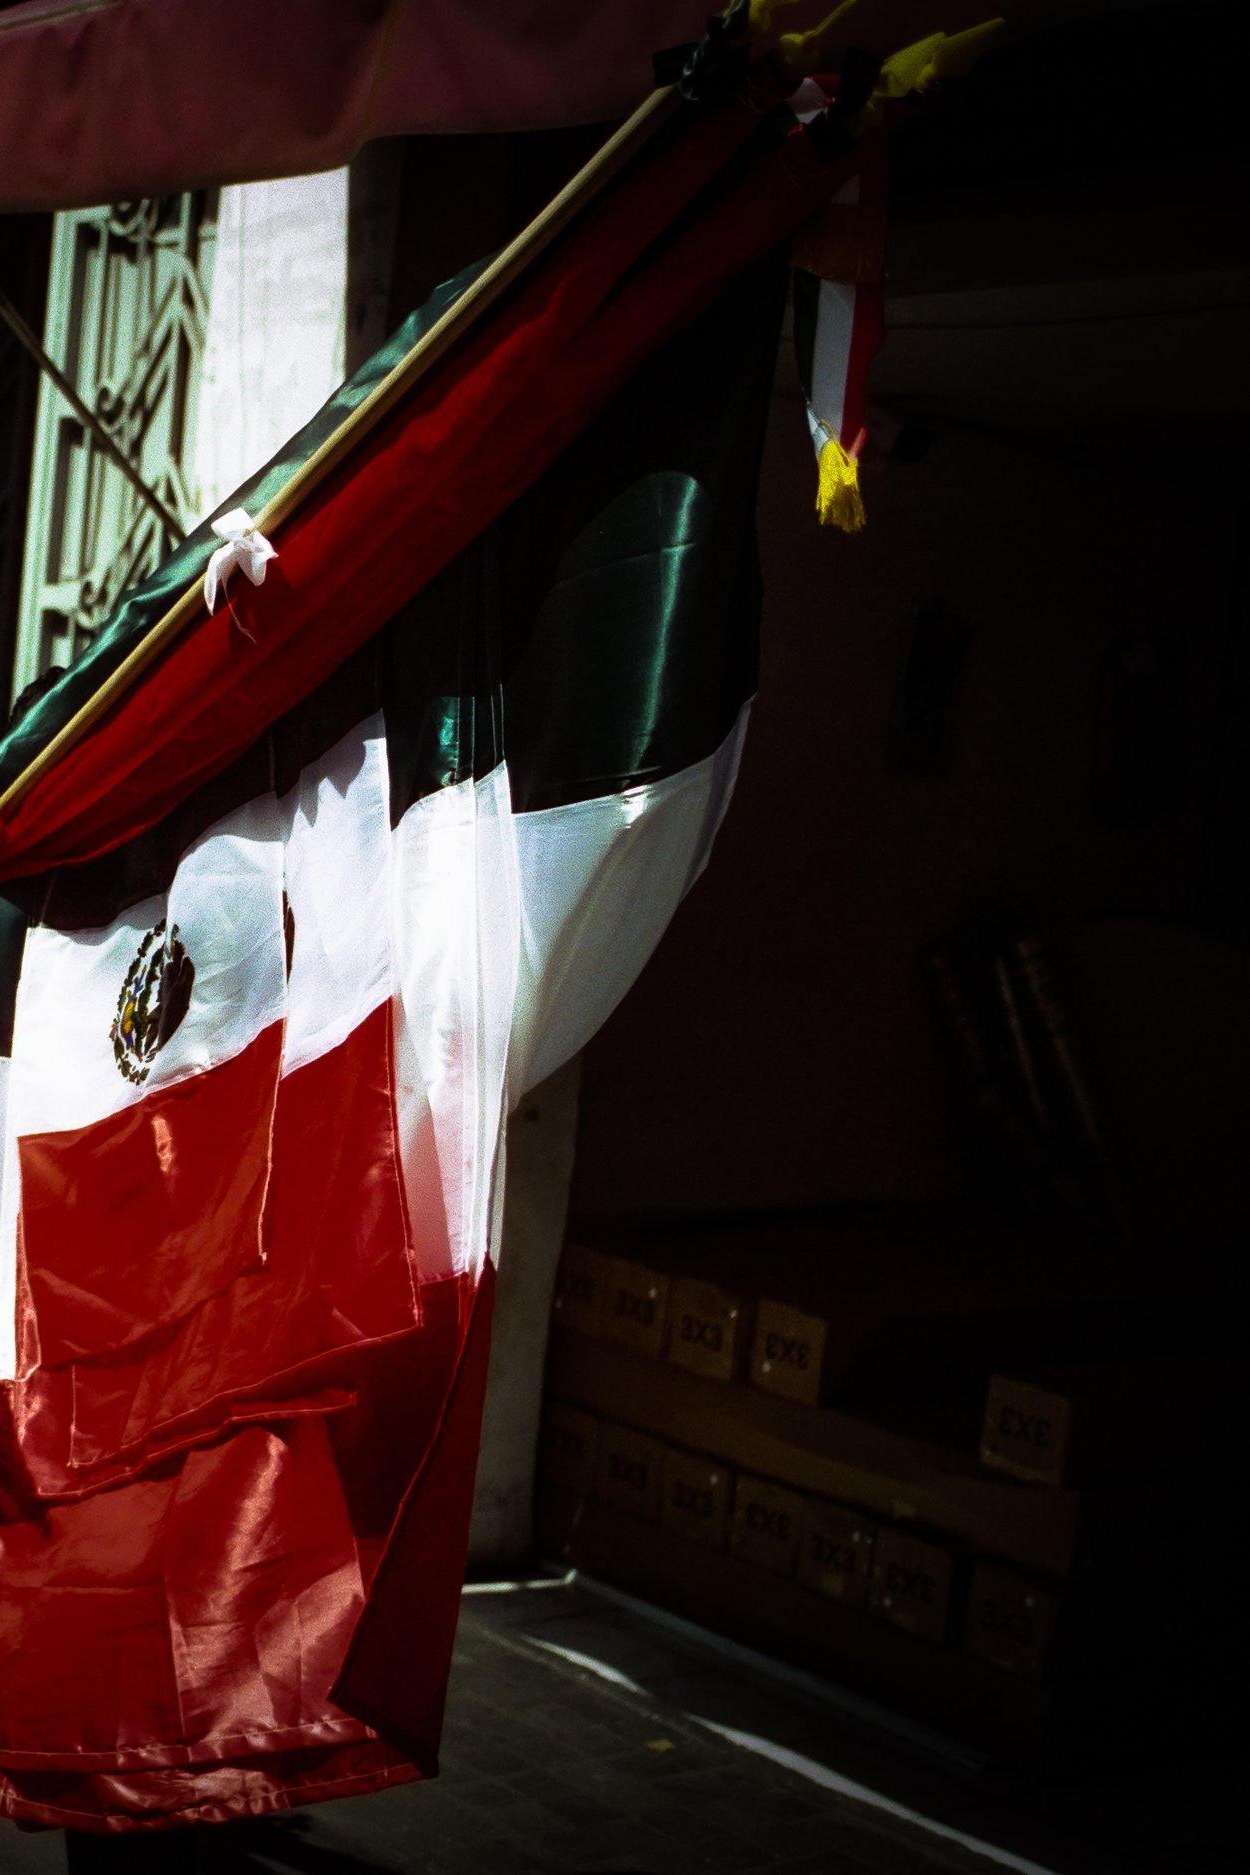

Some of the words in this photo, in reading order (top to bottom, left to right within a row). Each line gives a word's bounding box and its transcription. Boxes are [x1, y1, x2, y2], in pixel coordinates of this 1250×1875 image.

[681, 1314, 723, 1351] 3X3
[765, 1332, 810, 1370] 3X3
[999, 1406, 1050, 1449] 3X3
[746, 1502, 792, 1542] 3X3
[810, 1533, 855, 1574] 3X3
[886, 1562, 936, 1605] 3X3
[980, 1599, 1032, 1646] 3X3
